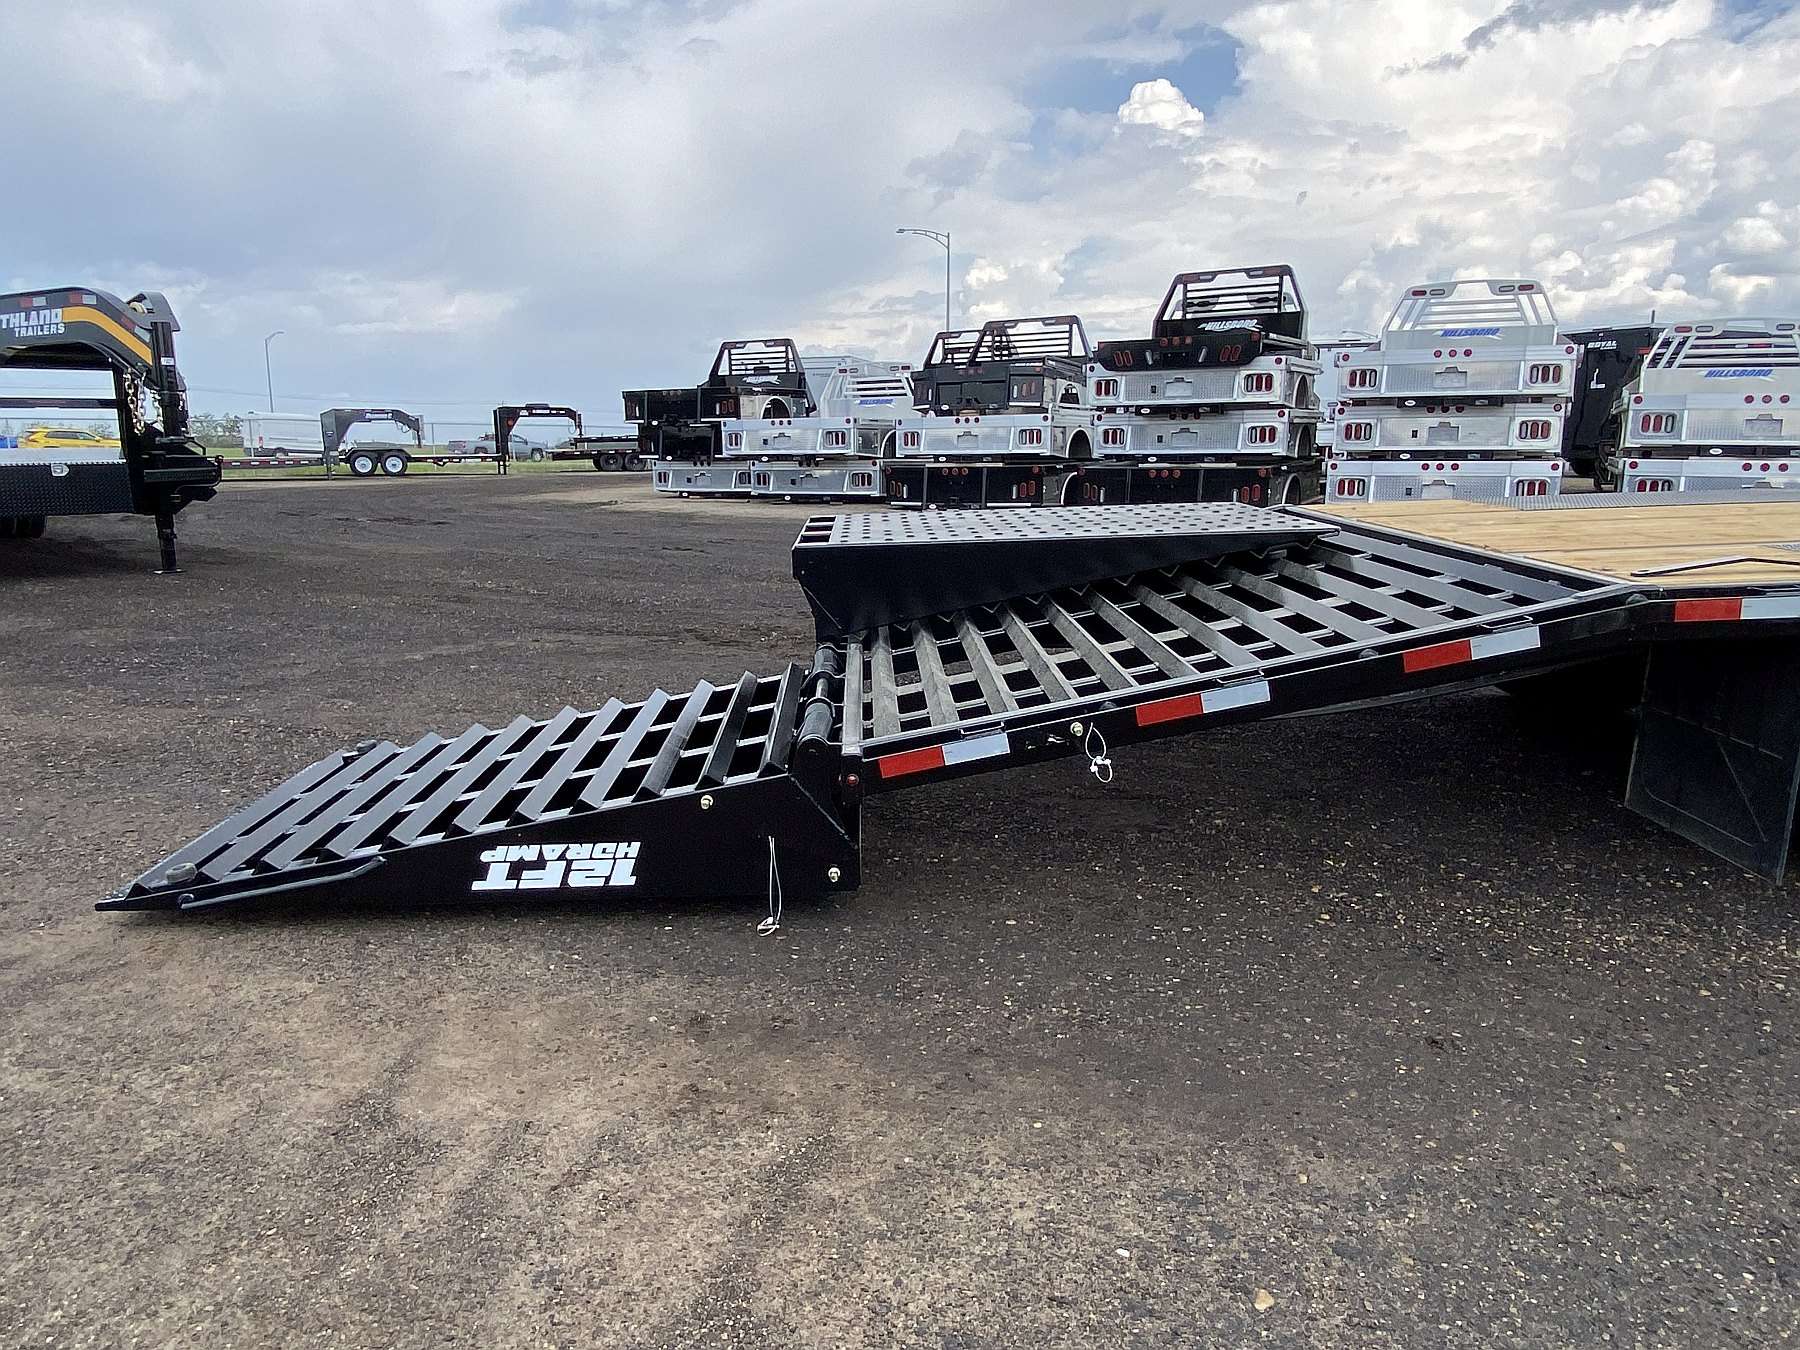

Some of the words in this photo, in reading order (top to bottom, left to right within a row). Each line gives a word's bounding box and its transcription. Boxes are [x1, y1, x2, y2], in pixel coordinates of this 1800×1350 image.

[1205, 319, 1258, 331] HILLSBORO
[14, 323, 65, 338] TRAILERS
[1440, 327, 1501, 337] HILLSBORO
[1587, 340, 1617, 349] ROYAL
[1704, 368, 1774, 378] HILLSBORO
